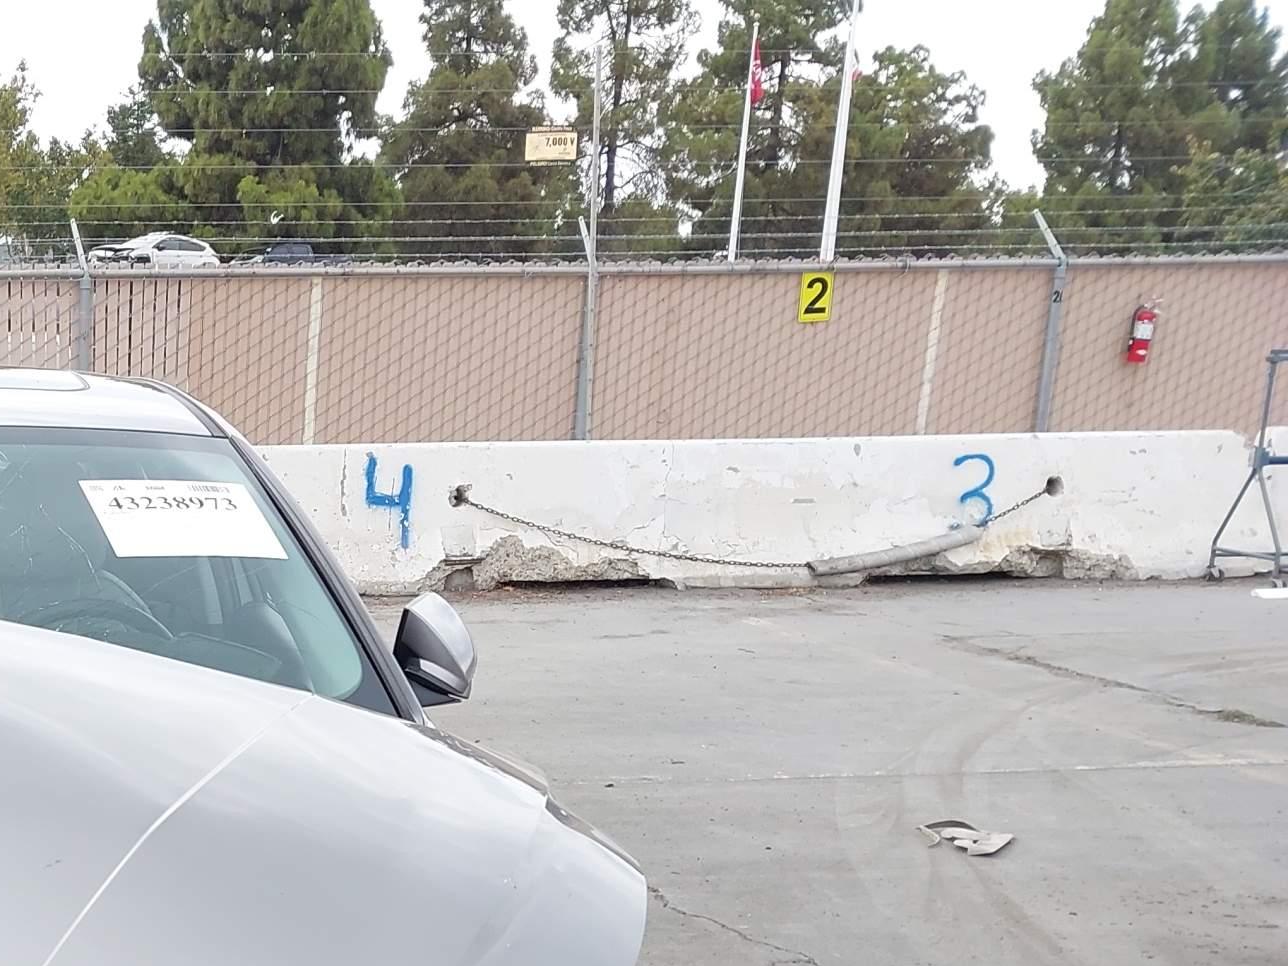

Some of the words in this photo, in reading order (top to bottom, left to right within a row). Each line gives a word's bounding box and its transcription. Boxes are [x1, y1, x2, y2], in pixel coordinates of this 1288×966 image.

[570, 137, 575, 146] V
[803, 277, 829, 314] 2
[108, 496, 238, 511] 43238973
[365, 451, 413, 549] 4
[953, 454, 995, 527] 3
